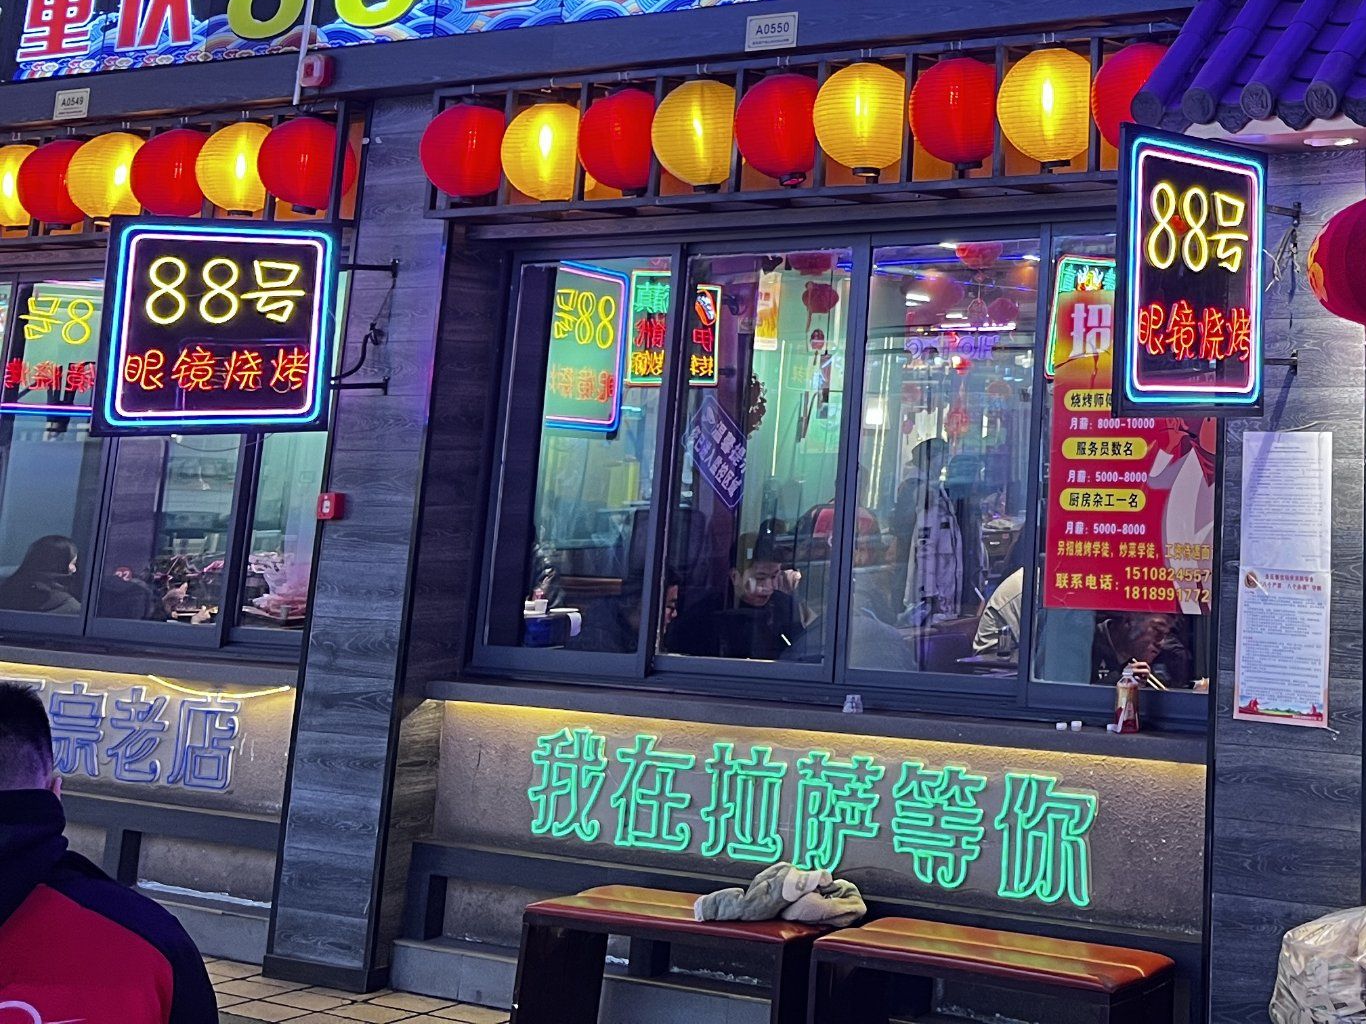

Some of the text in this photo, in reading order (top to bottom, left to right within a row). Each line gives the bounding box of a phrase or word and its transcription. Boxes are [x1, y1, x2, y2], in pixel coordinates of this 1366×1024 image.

[755, 21, 791, 36] A0550
[60, 95, 85, 108] A0549
[1143, 180, 1249, 273] 88号
[145, 255, 306, 325] 88号
[1136, 298, 1253, 362] 眼镜烧烤
[124, 344, 310, 392] 眼镜烧烤
[1075, 441, 1134, 457] 服务员数名
[1068, 492, 1139, 508] 厨房杂工一名
[8, 678, 241, 791] 宗老店
[527, 726, 1098, 908] 我在拉萨等你
